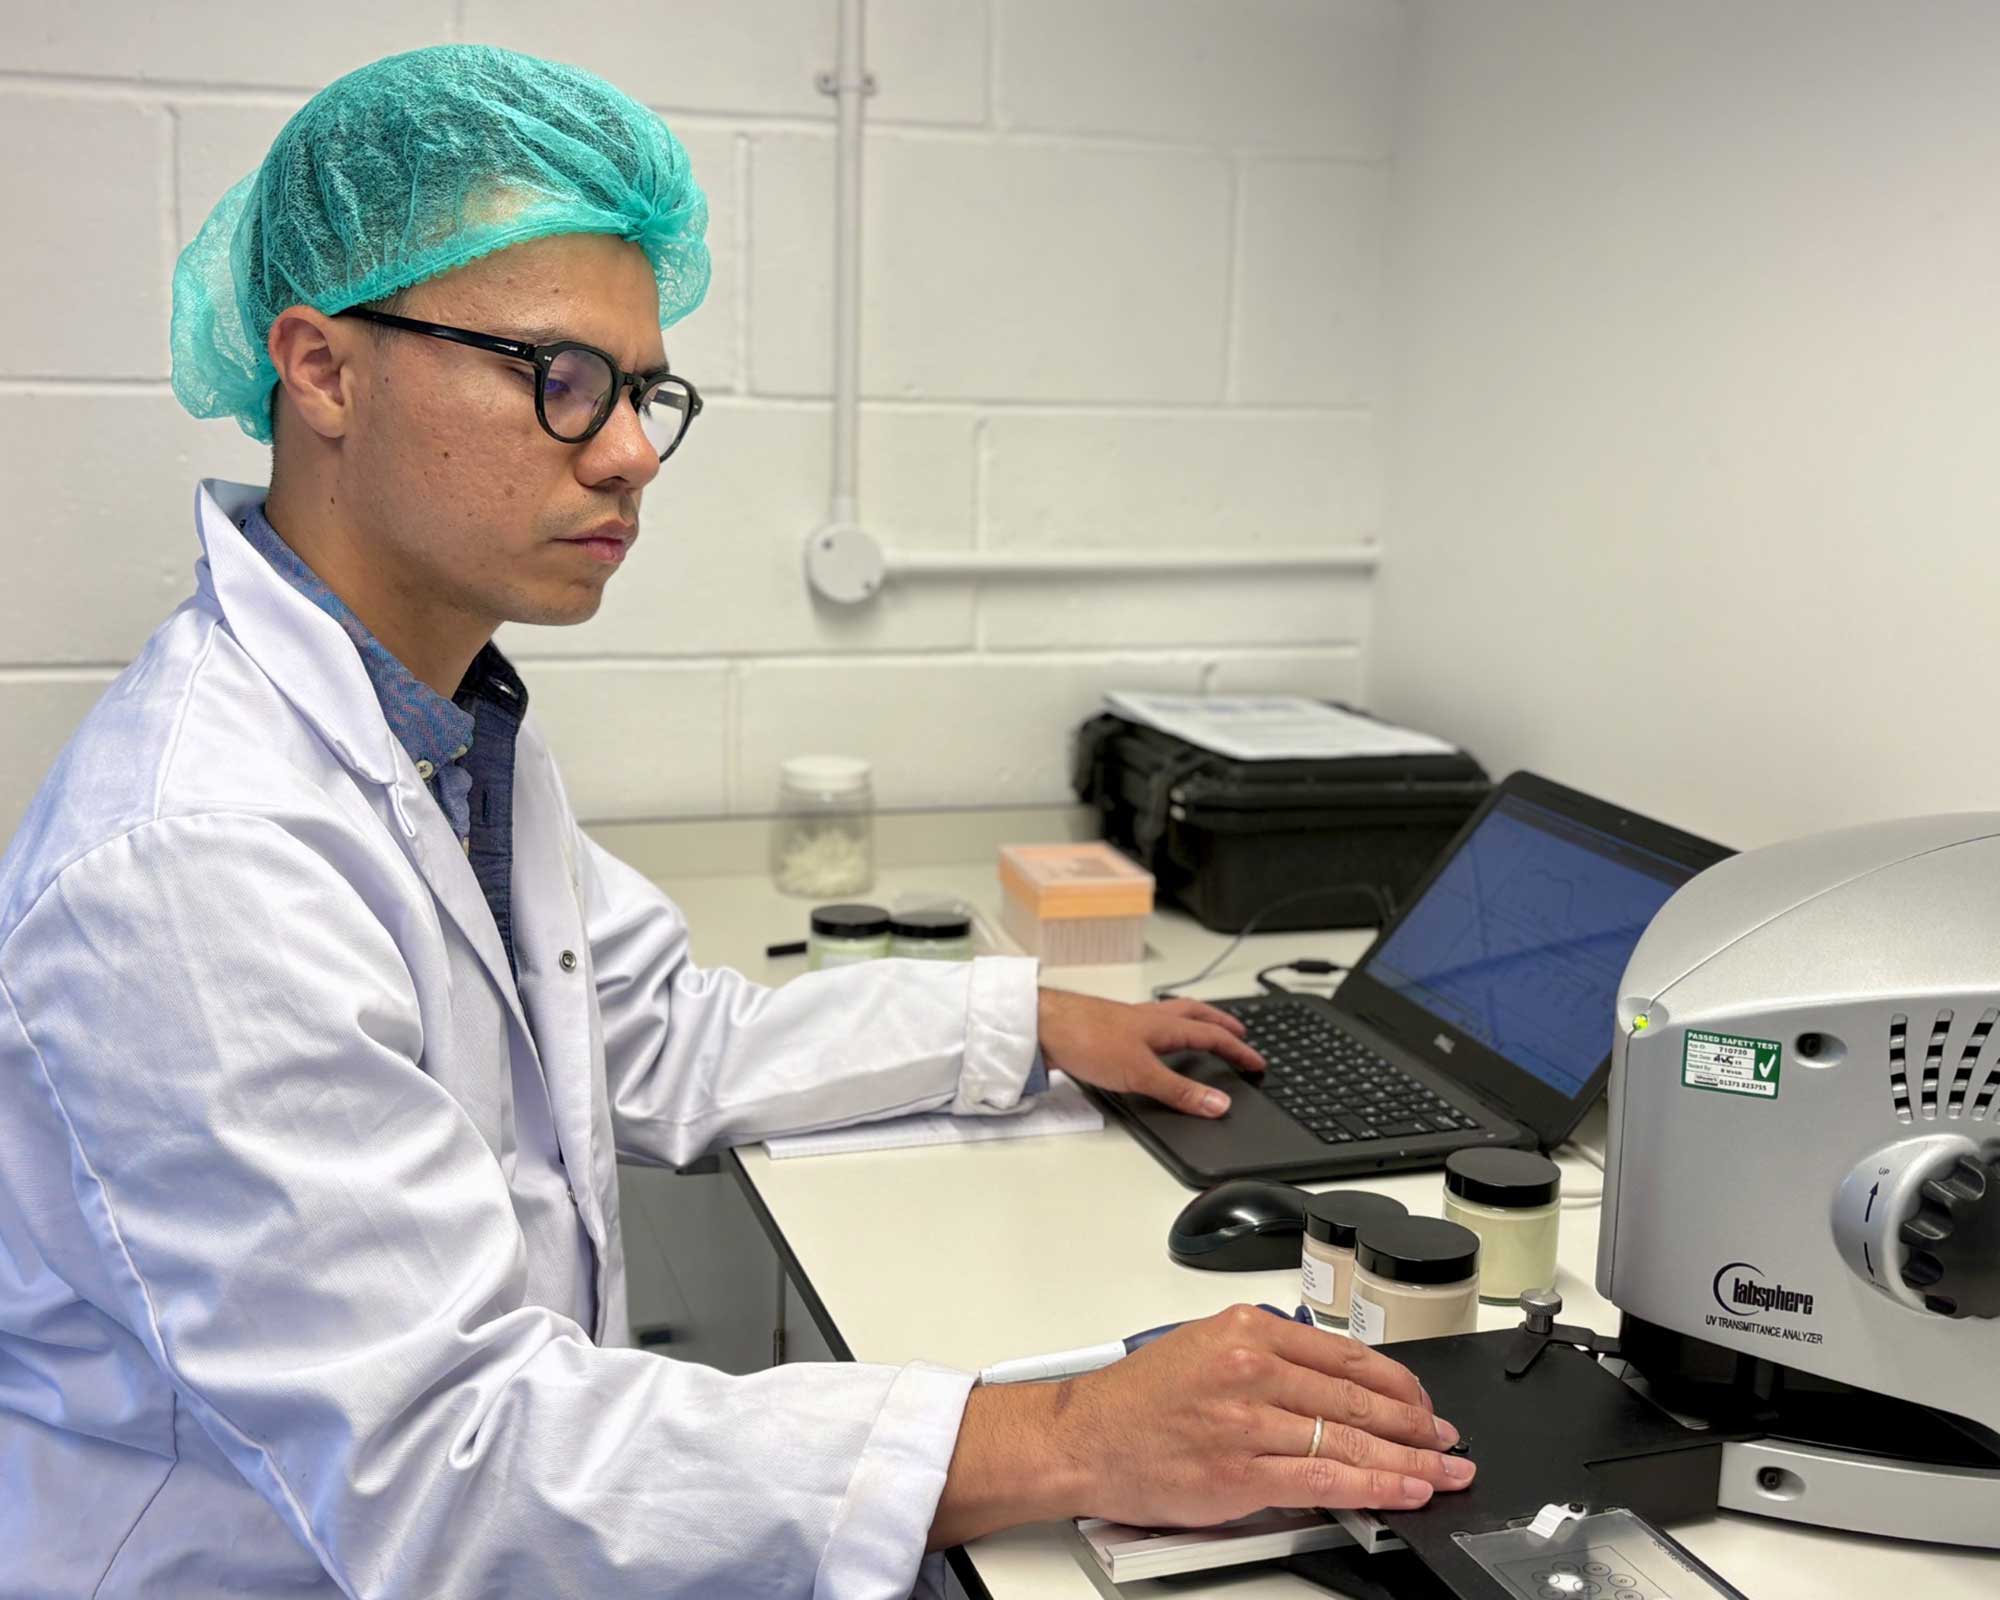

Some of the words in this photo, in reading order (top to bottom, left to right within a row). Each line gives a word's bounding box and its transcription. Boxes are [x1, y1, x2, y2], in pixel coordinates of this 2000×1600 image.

[1688, 1032, 1719, 1042] PASSED
[1722, 1037, 1754, 1047] SAFETY
[1757, 1042, 1779, 1050] TEST
[1733, 1278, 1814, 1315] labsphere
[1705, 1315, 1718, 1326] UV
[1719, 1317, 1782, 1338] TRANSMITTANCE
[1782, 1328, 1823, 1344] ANALYZER
